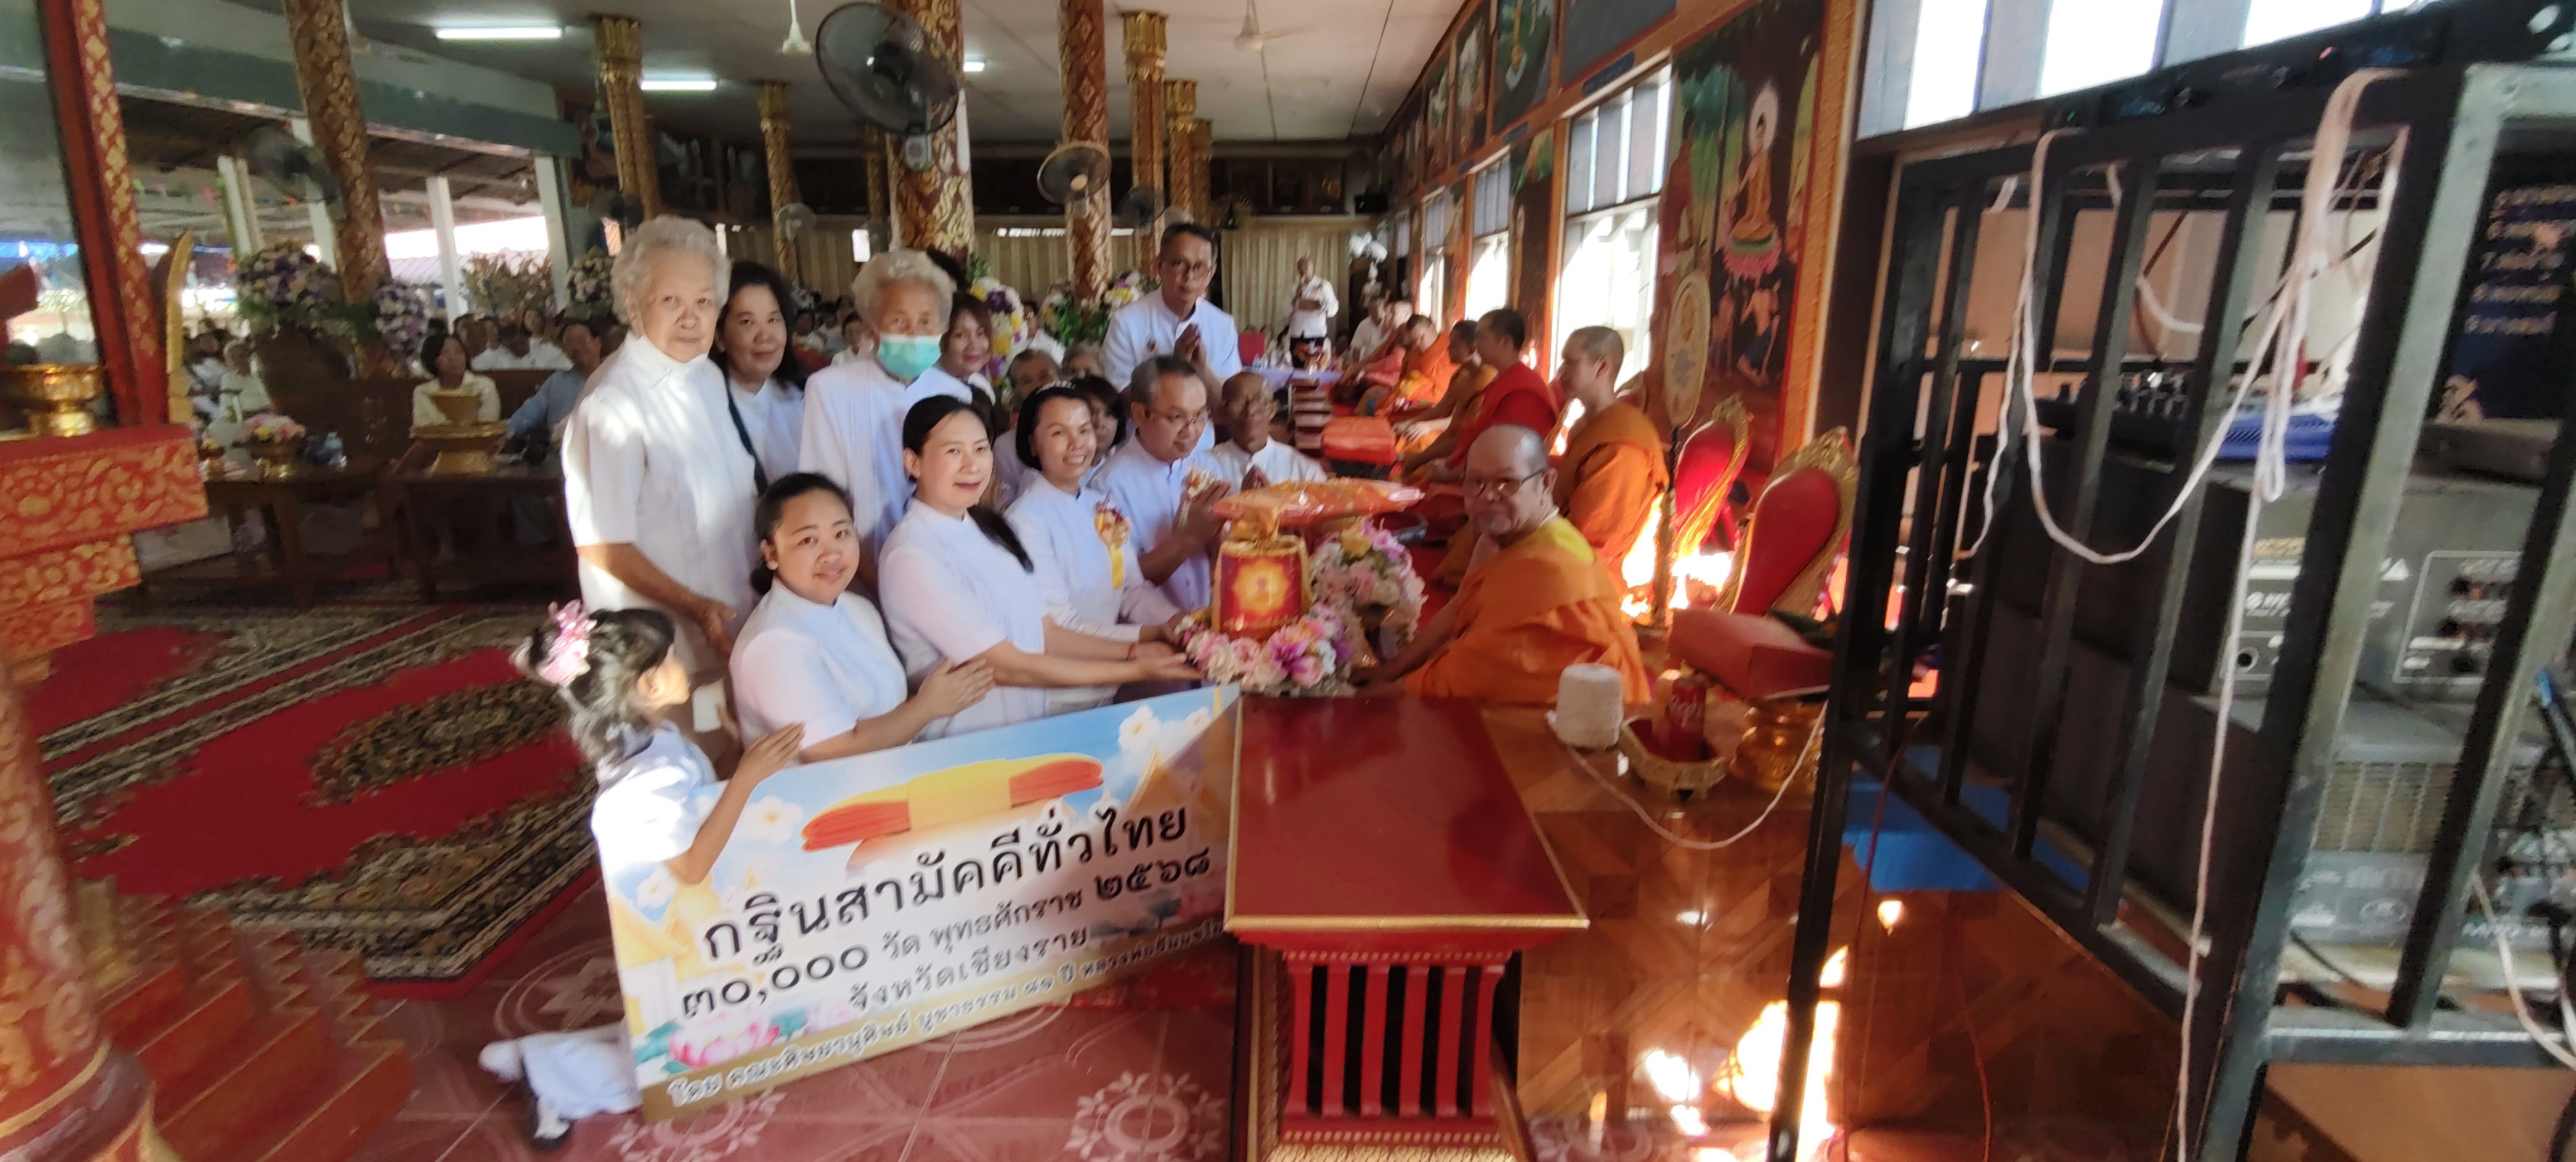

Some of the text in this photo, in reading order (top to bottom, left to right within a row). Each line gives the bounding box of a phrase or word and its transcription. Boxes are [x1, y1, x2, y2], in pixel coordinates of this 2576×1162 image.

[682, 847, 1211, 1017] ๓๐,๐๐๐ วัด พุทธศักราช ๒๕๖๘
[704, 805, 1186, 964] กฐินสามัคคีทั่วไทย
[849, 927, 1087, 1011] จังหวัดเชียงราย
